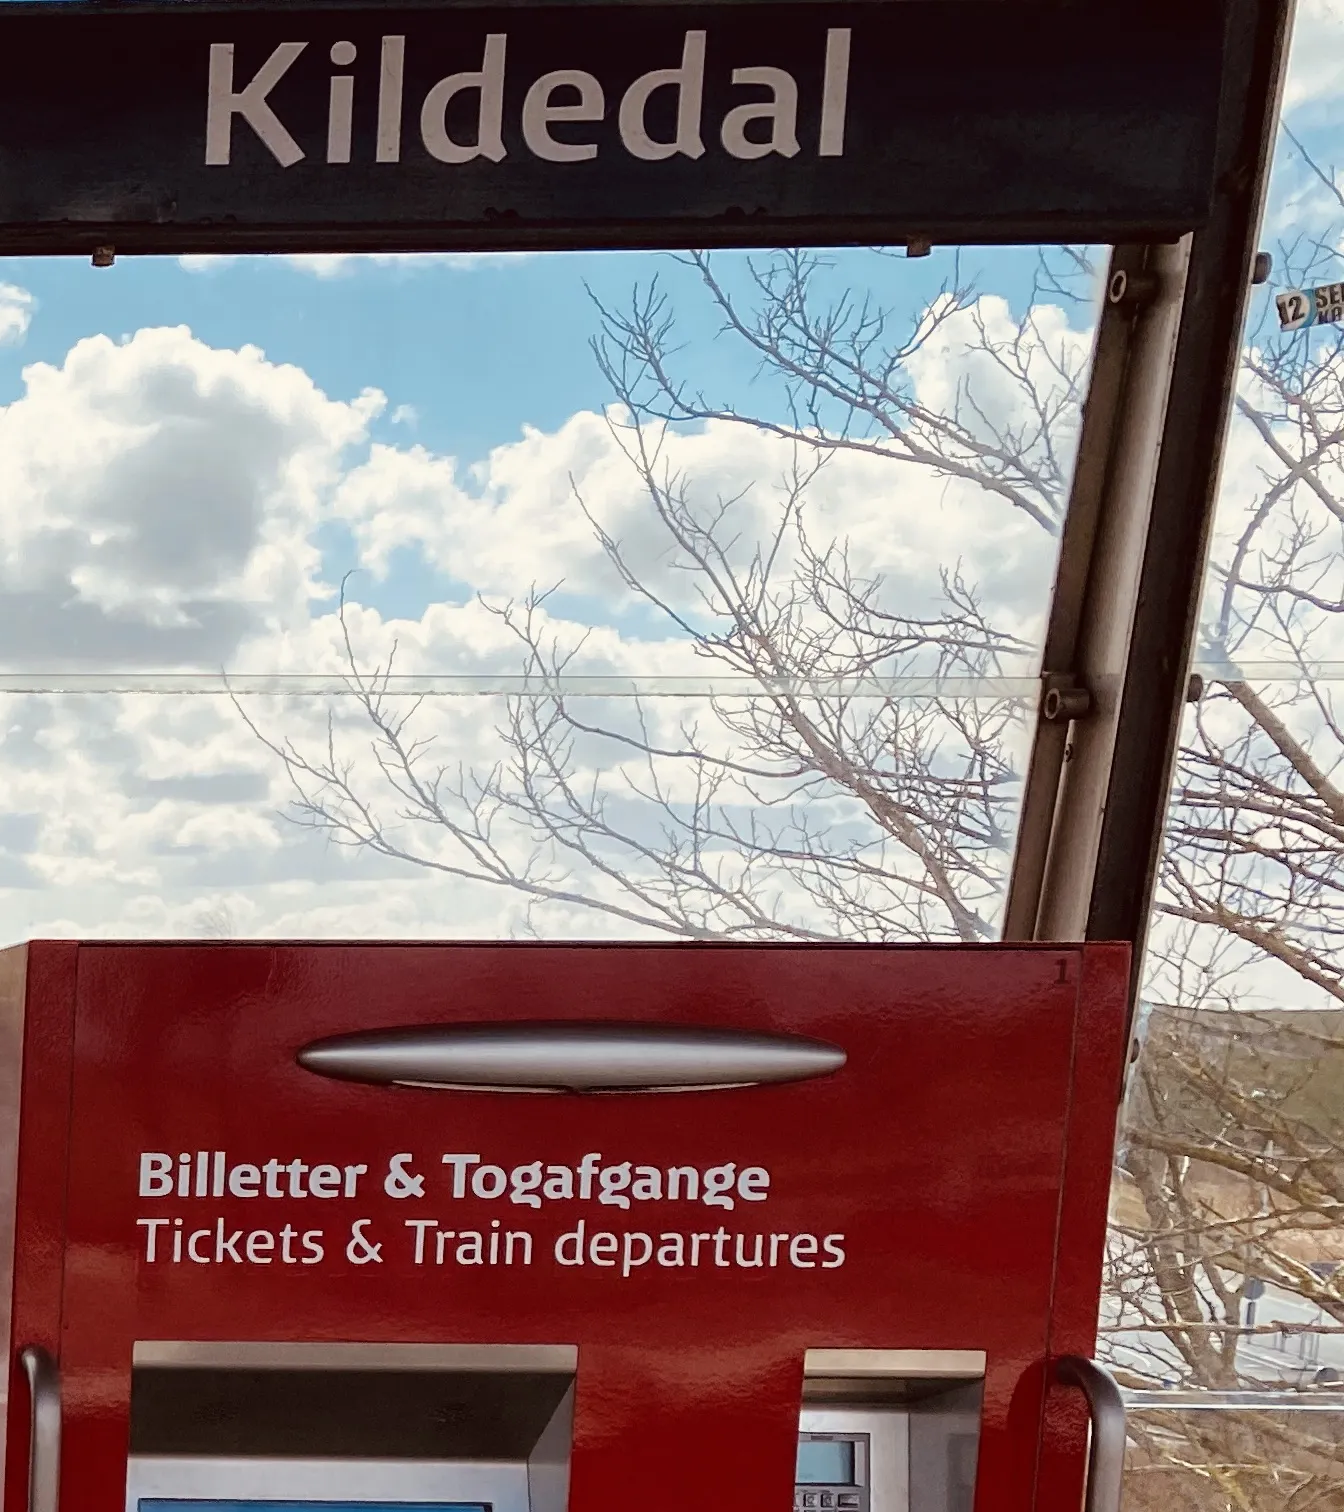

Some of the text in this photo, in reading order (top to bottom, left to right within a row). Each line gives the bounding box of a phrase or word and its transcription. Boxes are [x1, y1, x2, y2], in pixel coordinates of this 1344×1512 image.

[205, 28, 852, 168] Kildedal
[138, 1151, 771, 1210] Billetter & Togafgange
[137, 1217, 847, 1278] Tickets & Train departures
